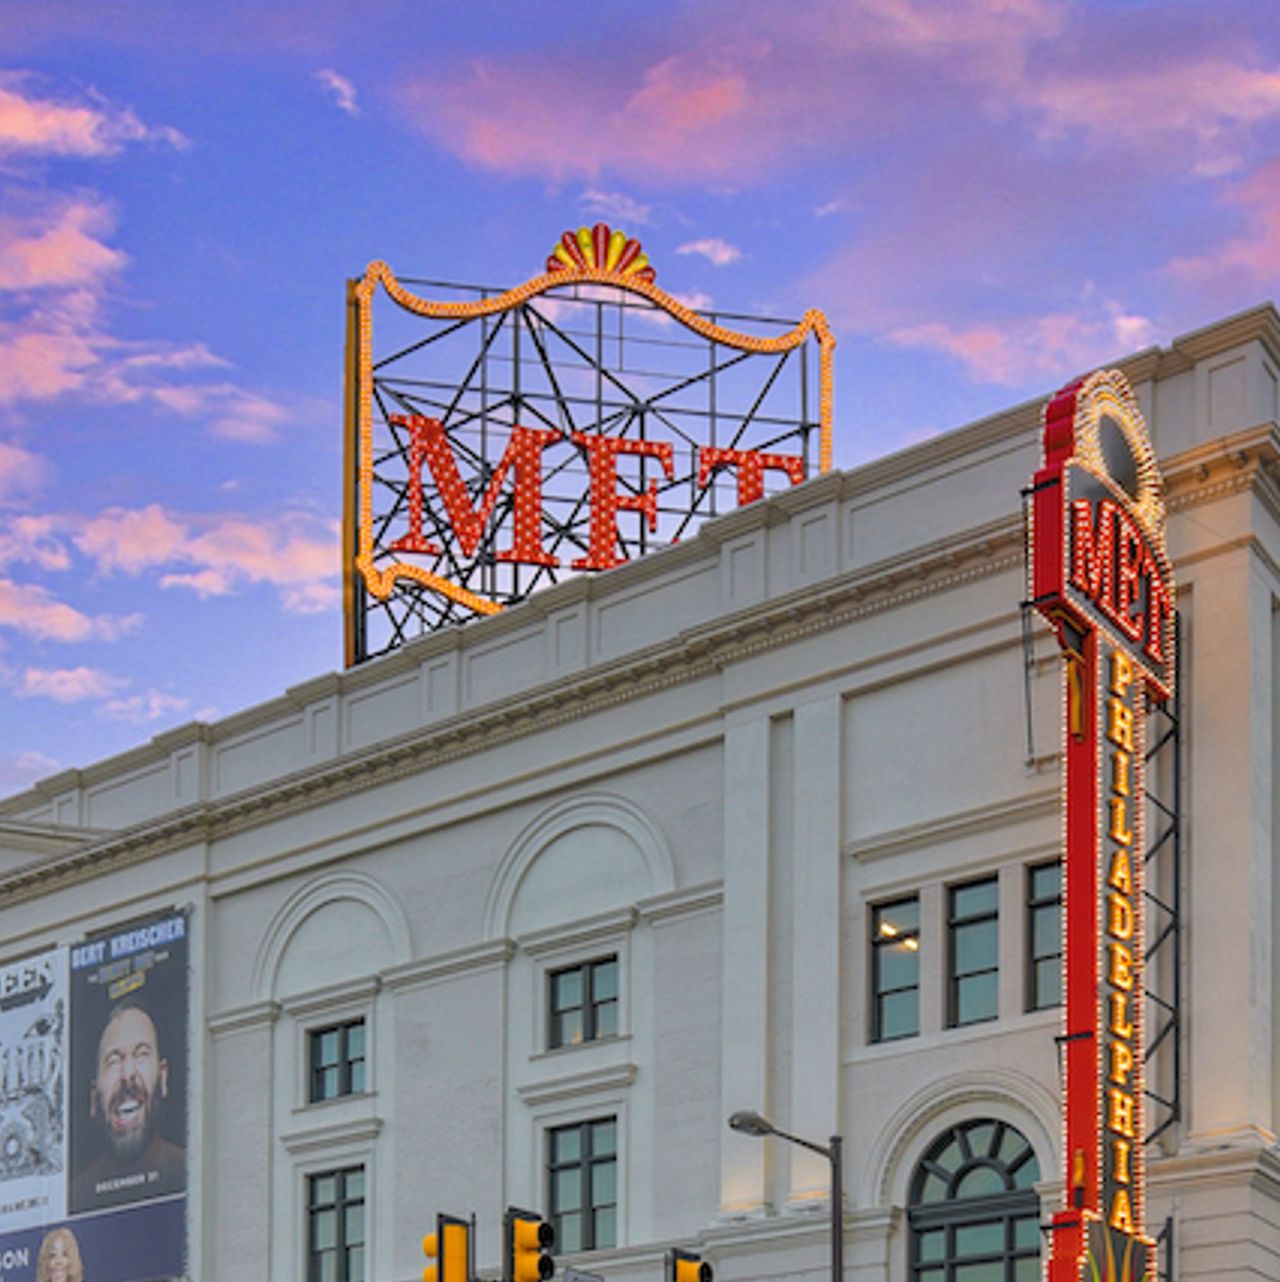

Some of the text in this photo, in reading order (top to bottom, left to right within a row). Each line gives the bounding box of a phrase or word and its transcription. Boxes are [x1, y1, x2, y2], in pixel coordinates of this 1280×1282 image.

[1071, 497, 1171, 663] MET
[72, 942, 107, 970] BERT
[110, 916, 185, 957] KREISCHER
[1108, 650, 1135, 1235] PHILADELPHIA
